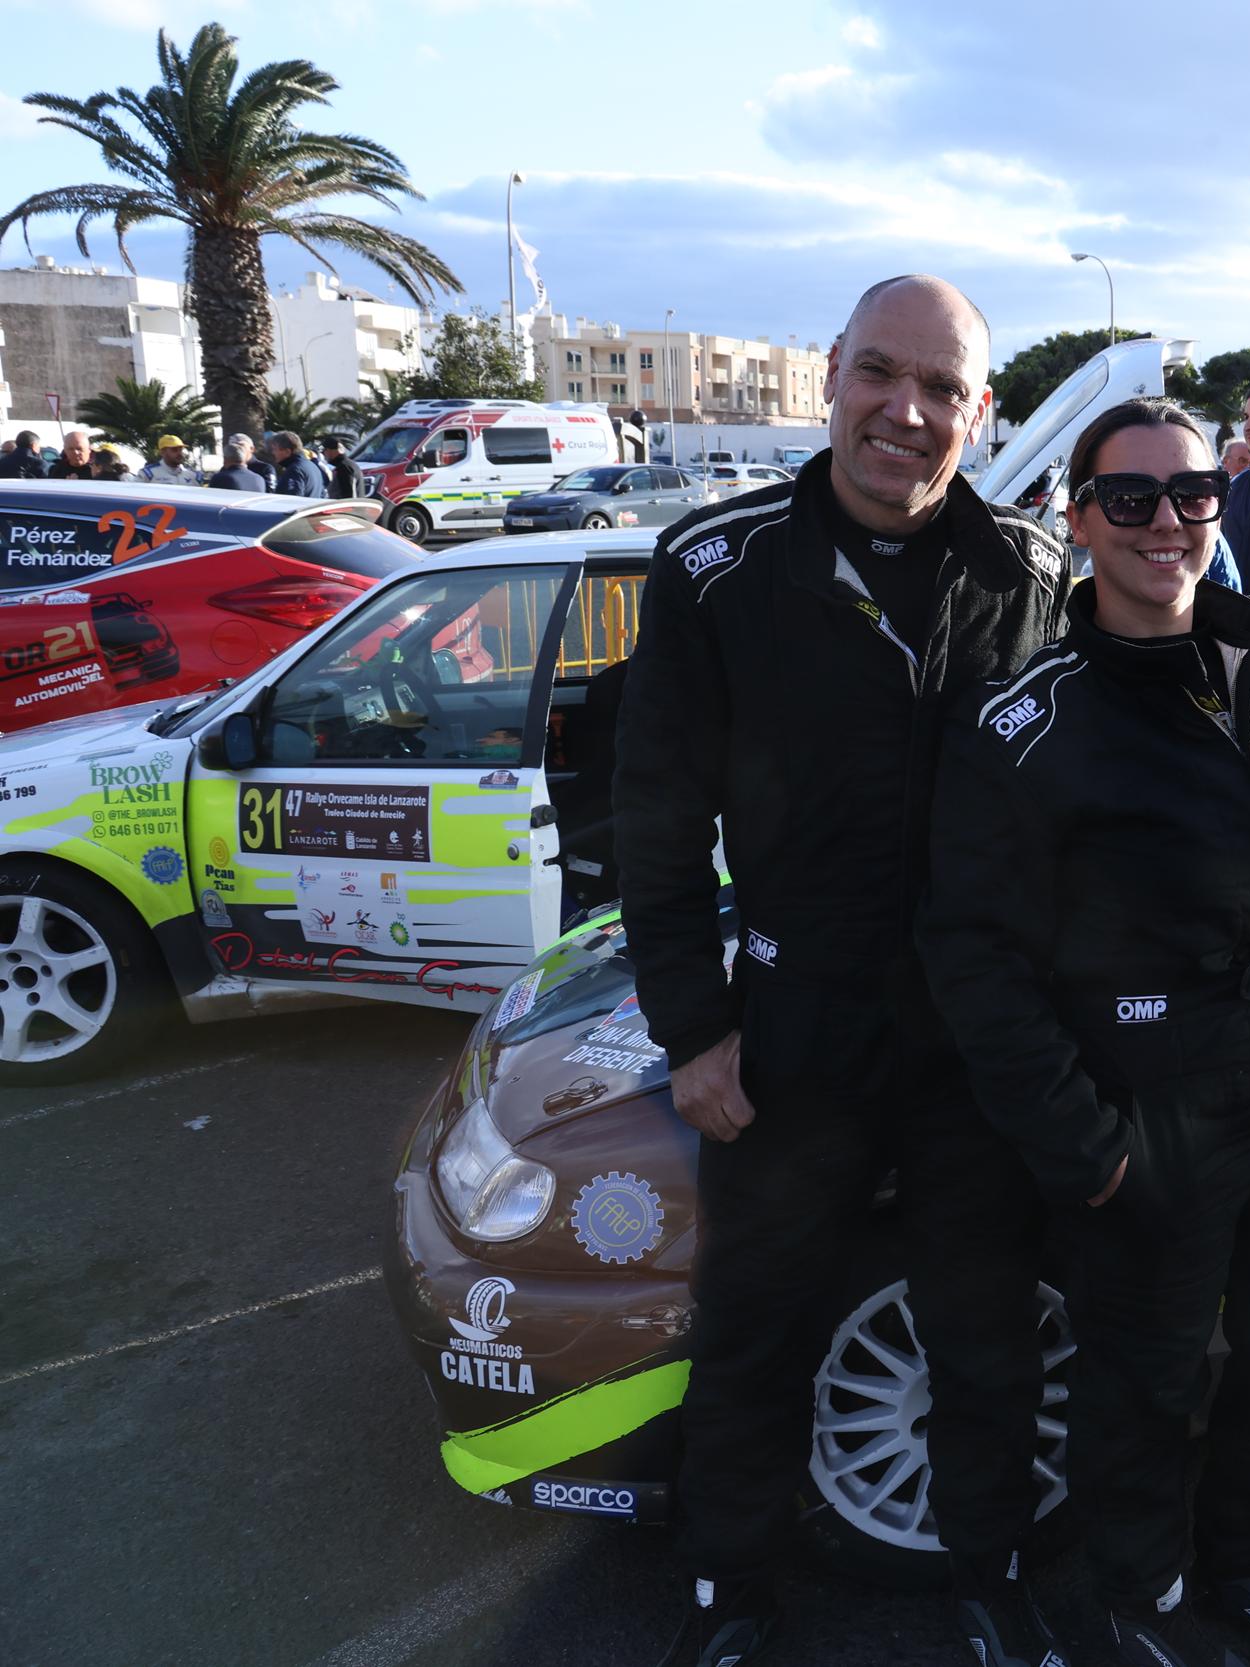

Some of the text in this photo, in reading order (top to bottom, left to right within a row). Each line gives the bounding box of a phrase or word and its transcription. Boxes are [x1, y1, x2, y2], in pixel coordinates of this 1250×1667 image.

[10, 525, 76, 544] Pérez
[97, 503, 189, 566] 22
[7, 549, 112, 567] Fernández
[684, 539, 728, 573] OMP
[1030, 543, 1061, 575] OMP
[38, 662, 101, 687] MECANICA
[15, 682, 86, 707] AUTOMOVIL
[995, 698, 1037, 737] OMP
[90, 764, 162, 787] BROW
[14, 785, 37, 799] 799
[103, 782, 171, 805] LASH
[242, 787, 426, 850] 31 47 Rallye Orvecame Isla de Lanzarote
[324, 808, 406, 820] Trofeo Ciudad de Arrecife
[109, 822, 179, 837] 646 619 071
[288, 835, 339, 846] LANZAROTE
[748, 934, 778, 962] OMP
[1116, 999, 1168, 1021] OMP
[587, 1025, 632, 1044] UNA
[562, 1044, 662, 1075] DIFERENTE
[449, 1337, 523, 1360] NEUMATICOS
[440, 1351, 536, 1396] CATELA
[533, 1480, 634, 1510] sparco
